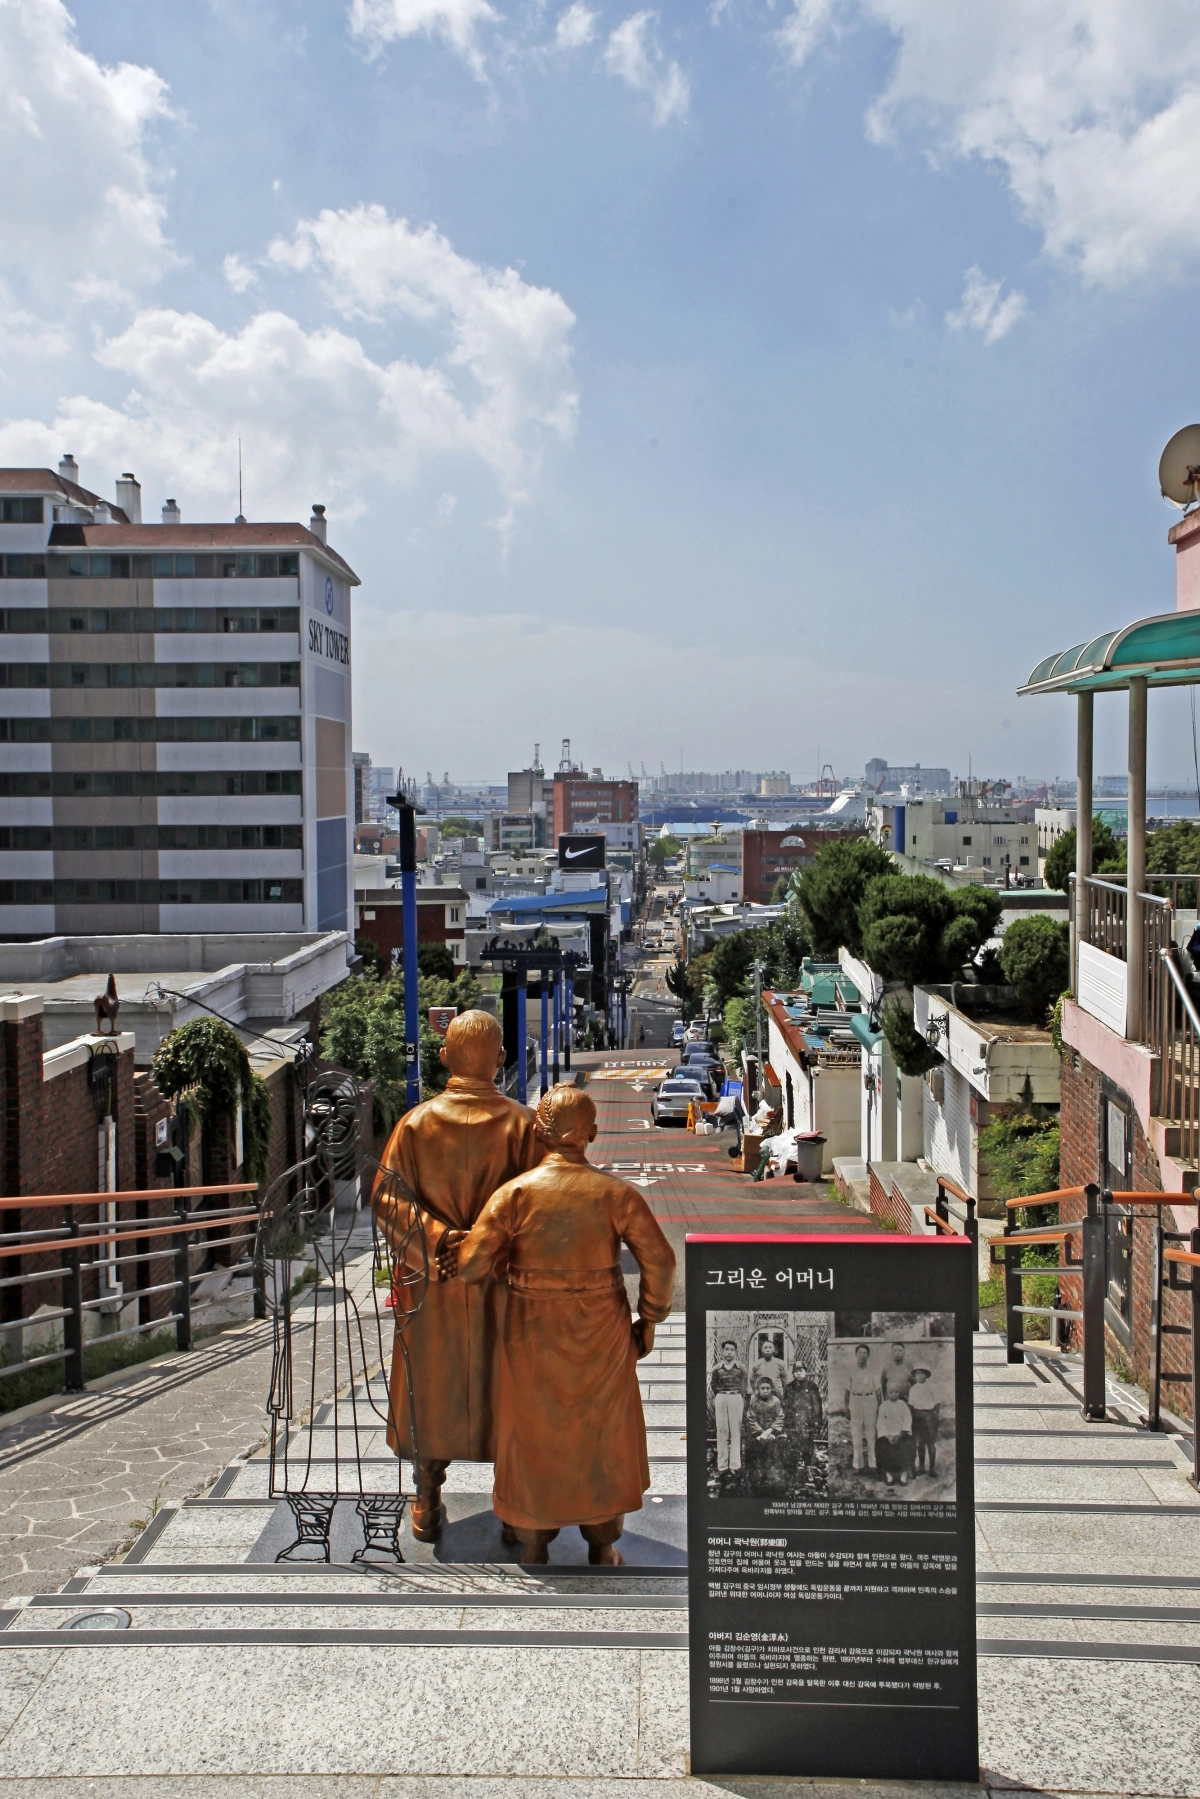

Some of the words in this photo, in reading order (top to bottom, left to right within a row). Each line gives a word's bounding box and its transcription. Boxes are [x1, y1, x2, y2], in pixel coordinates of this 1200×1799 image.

[308, 618, 324, 655] SKY
[325, 626, 350, 665] TOWER
[590, 1162, 708, 1173] 진입금
[705, 1268, 768, 1290] 그리운
[775, 1268, 835, 1291] 어머니
[708, 1537, 730, 1546] 어머니
[708, 1632, 732, 1641] 아버지
